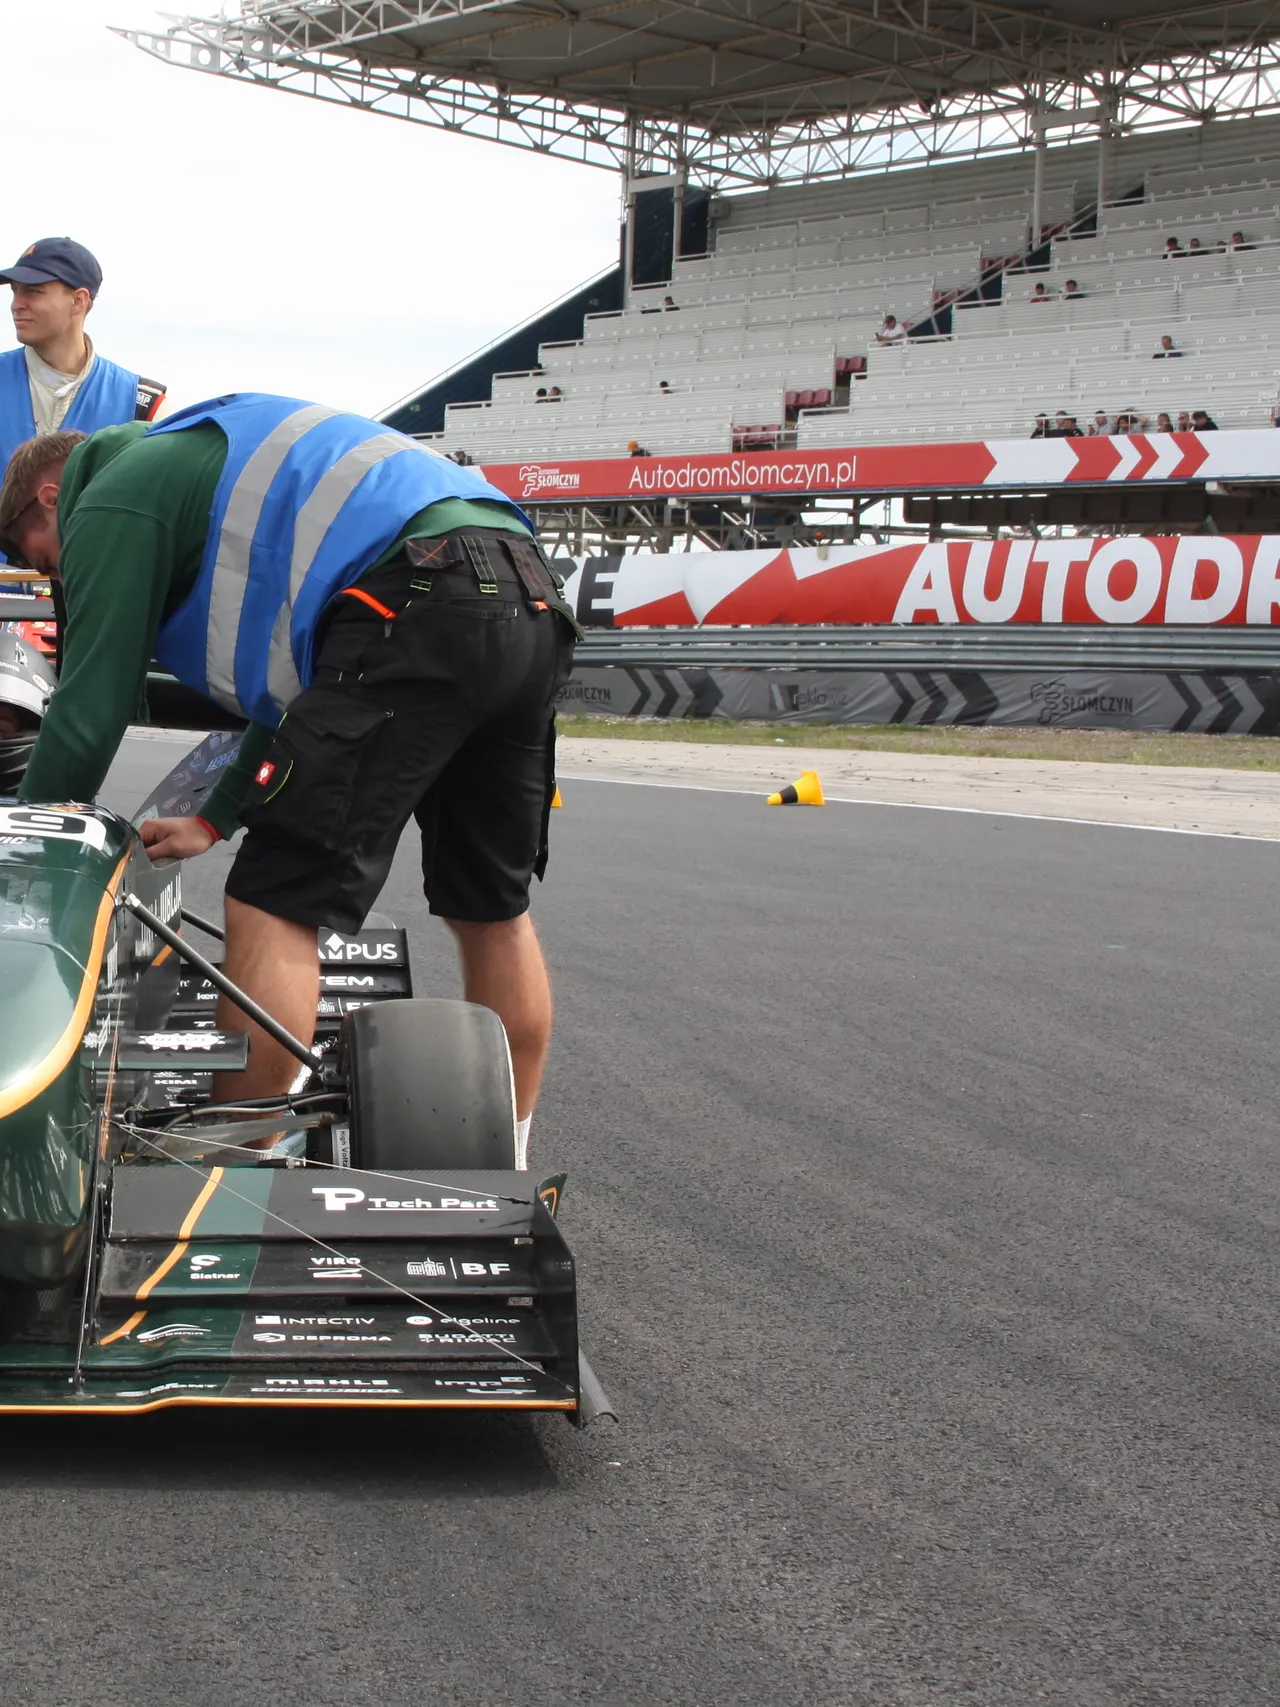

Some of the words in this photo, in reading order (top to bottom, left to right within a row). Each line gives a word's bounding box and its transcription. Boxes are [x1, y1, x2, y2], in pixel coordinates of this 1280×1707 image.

[628, 455, 857, 489] AutodromSlomczyn.pl
[319, 975, 374, 986] EM
[368, 1198, 433, 1208] Tech
[440, 1198, 497, 1208] Part
[310, 1257, 361, 1265] VIRO
[461, 1262, 511, 1275] BF
[282, 1317, 376, 1325] INTECTIV
